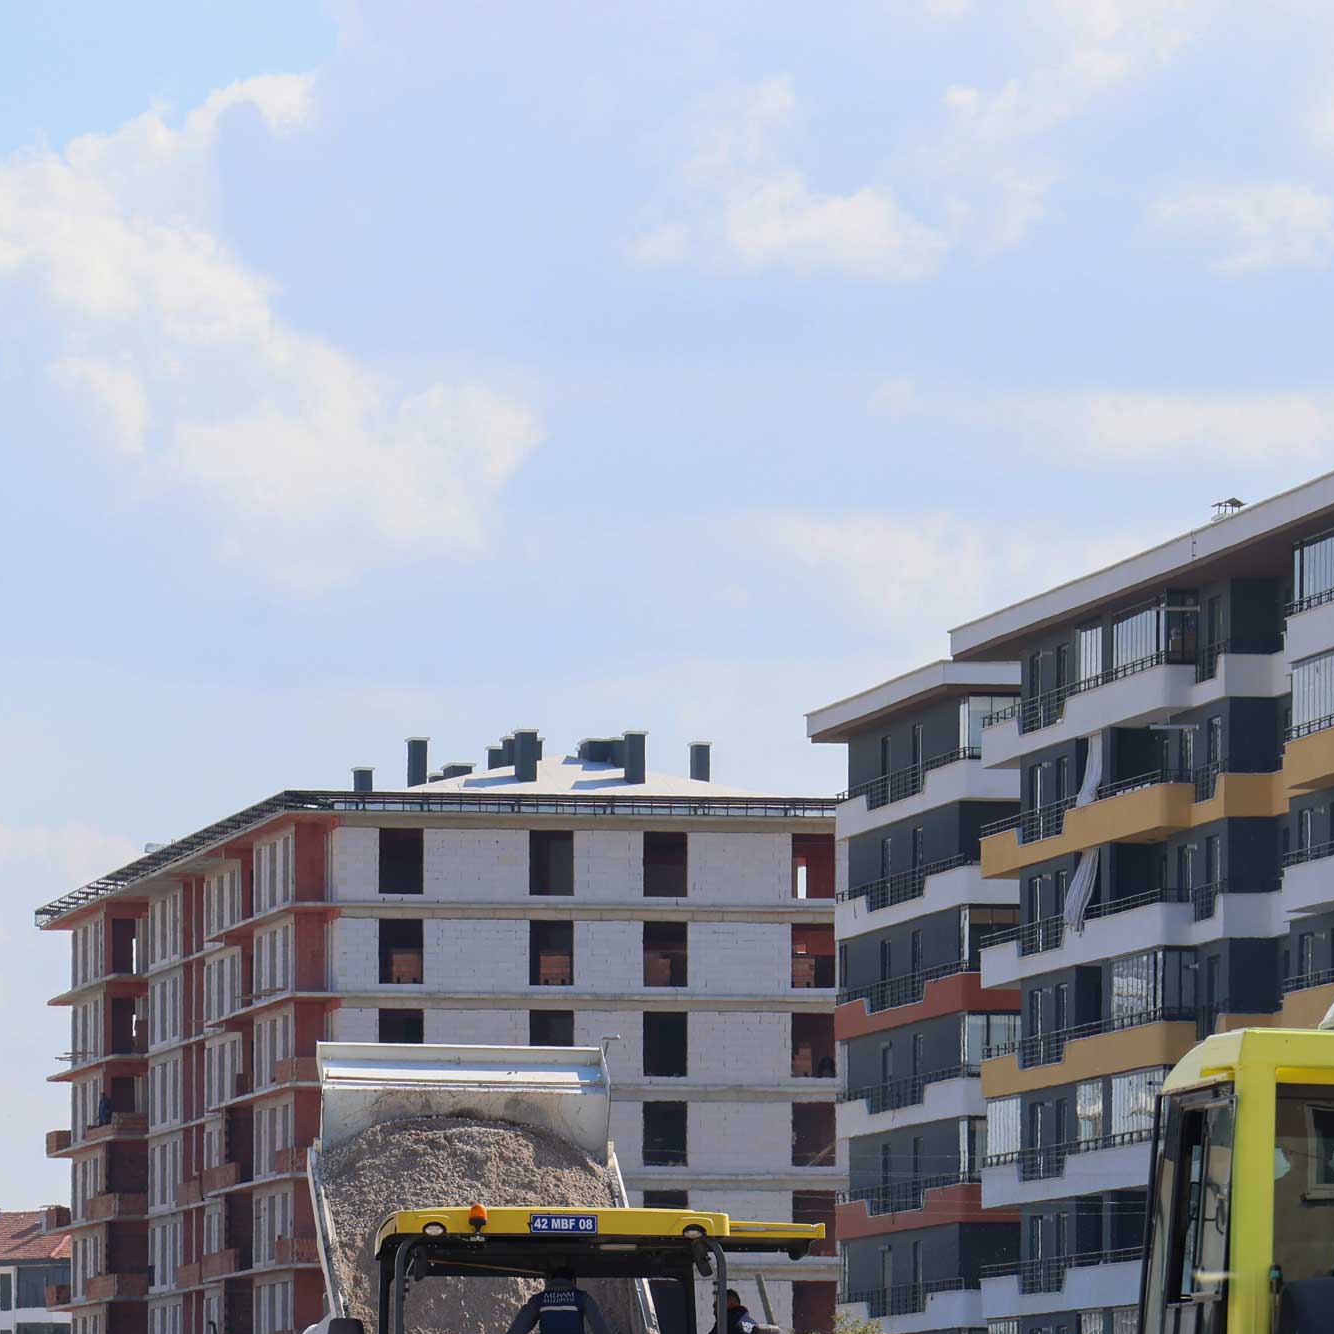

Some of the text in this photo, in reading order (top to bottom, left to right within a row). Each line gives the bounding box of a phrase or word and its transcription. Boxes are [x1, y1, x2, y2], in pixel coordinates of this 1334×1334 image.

[534, 1218, 593, 1230] 42 MBF 08
